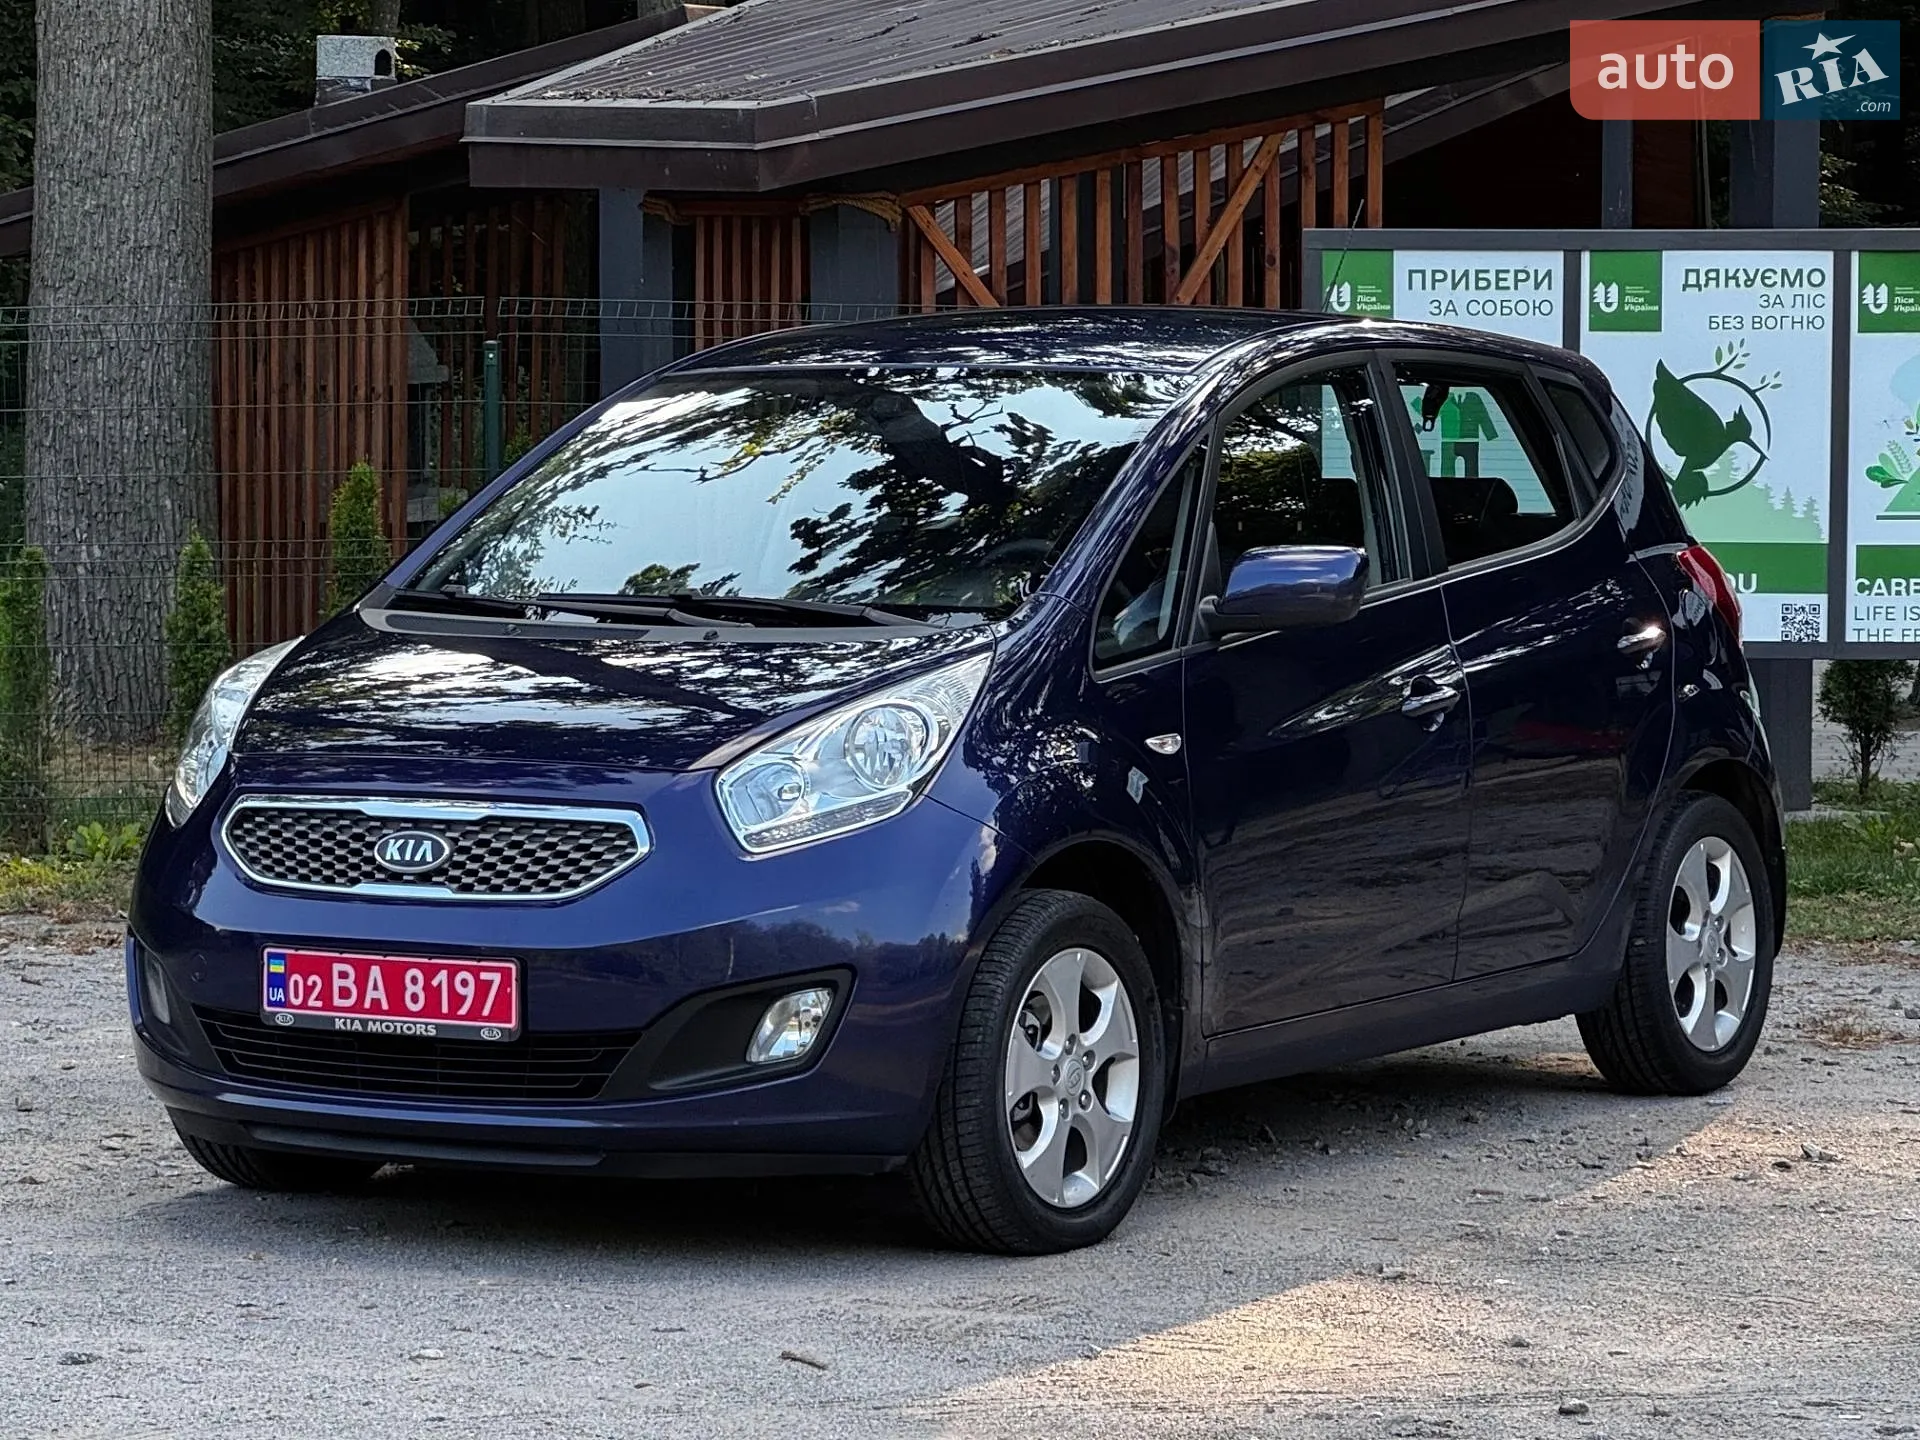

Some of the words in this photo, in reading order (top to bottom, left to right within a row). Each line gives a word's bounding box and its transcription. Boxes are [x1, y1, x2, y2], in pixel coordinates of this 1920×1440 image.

[1408, 269, 1553, 291] ПРИБЕРИ
[1682, 268, 1826, 292] ДЯКУЄМО
[1429, 300, 1458, 317] ЗА
[1466, 299, 1554, 317] СОБОЮ
[1759, 294, 1785, 309] ЗА
[1791, 294, 1826, 309] ЛІС
[1709, 316, 1744, 330] БЕЗ
[1752, 315, 1825, 330] ВОГНЮ
[1854, 606, 1896, 621] LIFE
[385, 838, 433, 862] KIA
[269, 986, 285, 1002] UA
[289, 973, 323, 1008] 02
[404, 968, 502, 1017] 8197
[334, 1017, 363, 1032] KIA
[367, 1020, 437, 1036] MOTORS
